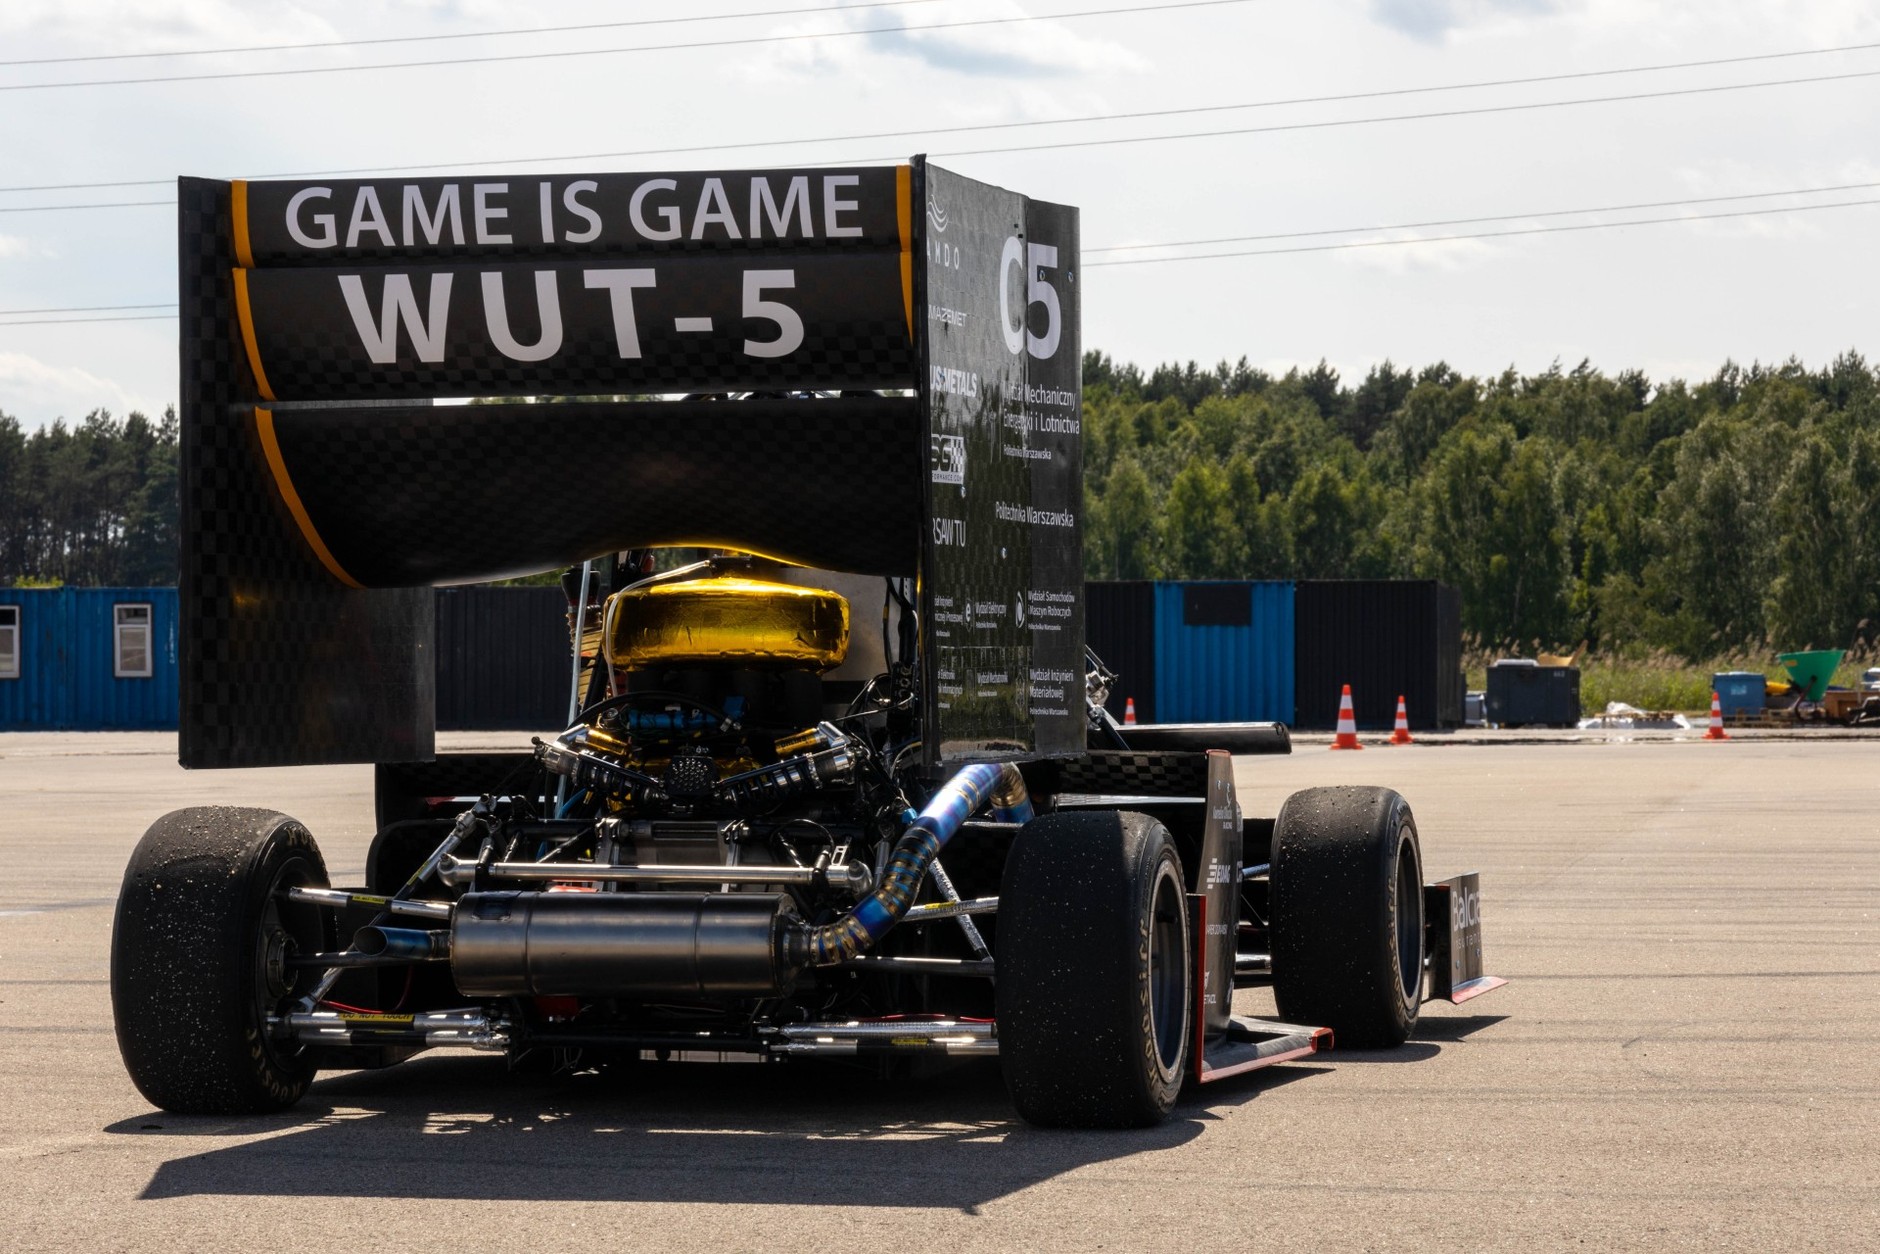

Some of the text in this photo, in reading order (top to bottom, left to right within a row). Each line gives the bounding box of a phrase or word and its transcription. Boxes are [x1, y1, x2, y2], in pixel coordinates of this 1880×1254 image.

[285, 175, 863, 249] GAME IS GAME
[1024, 383, 1076, 411] Mechaniczny
[1040, 413, 1080, 435] Lotnictwa
[1026, 506, 1074, 528] Warszawska
